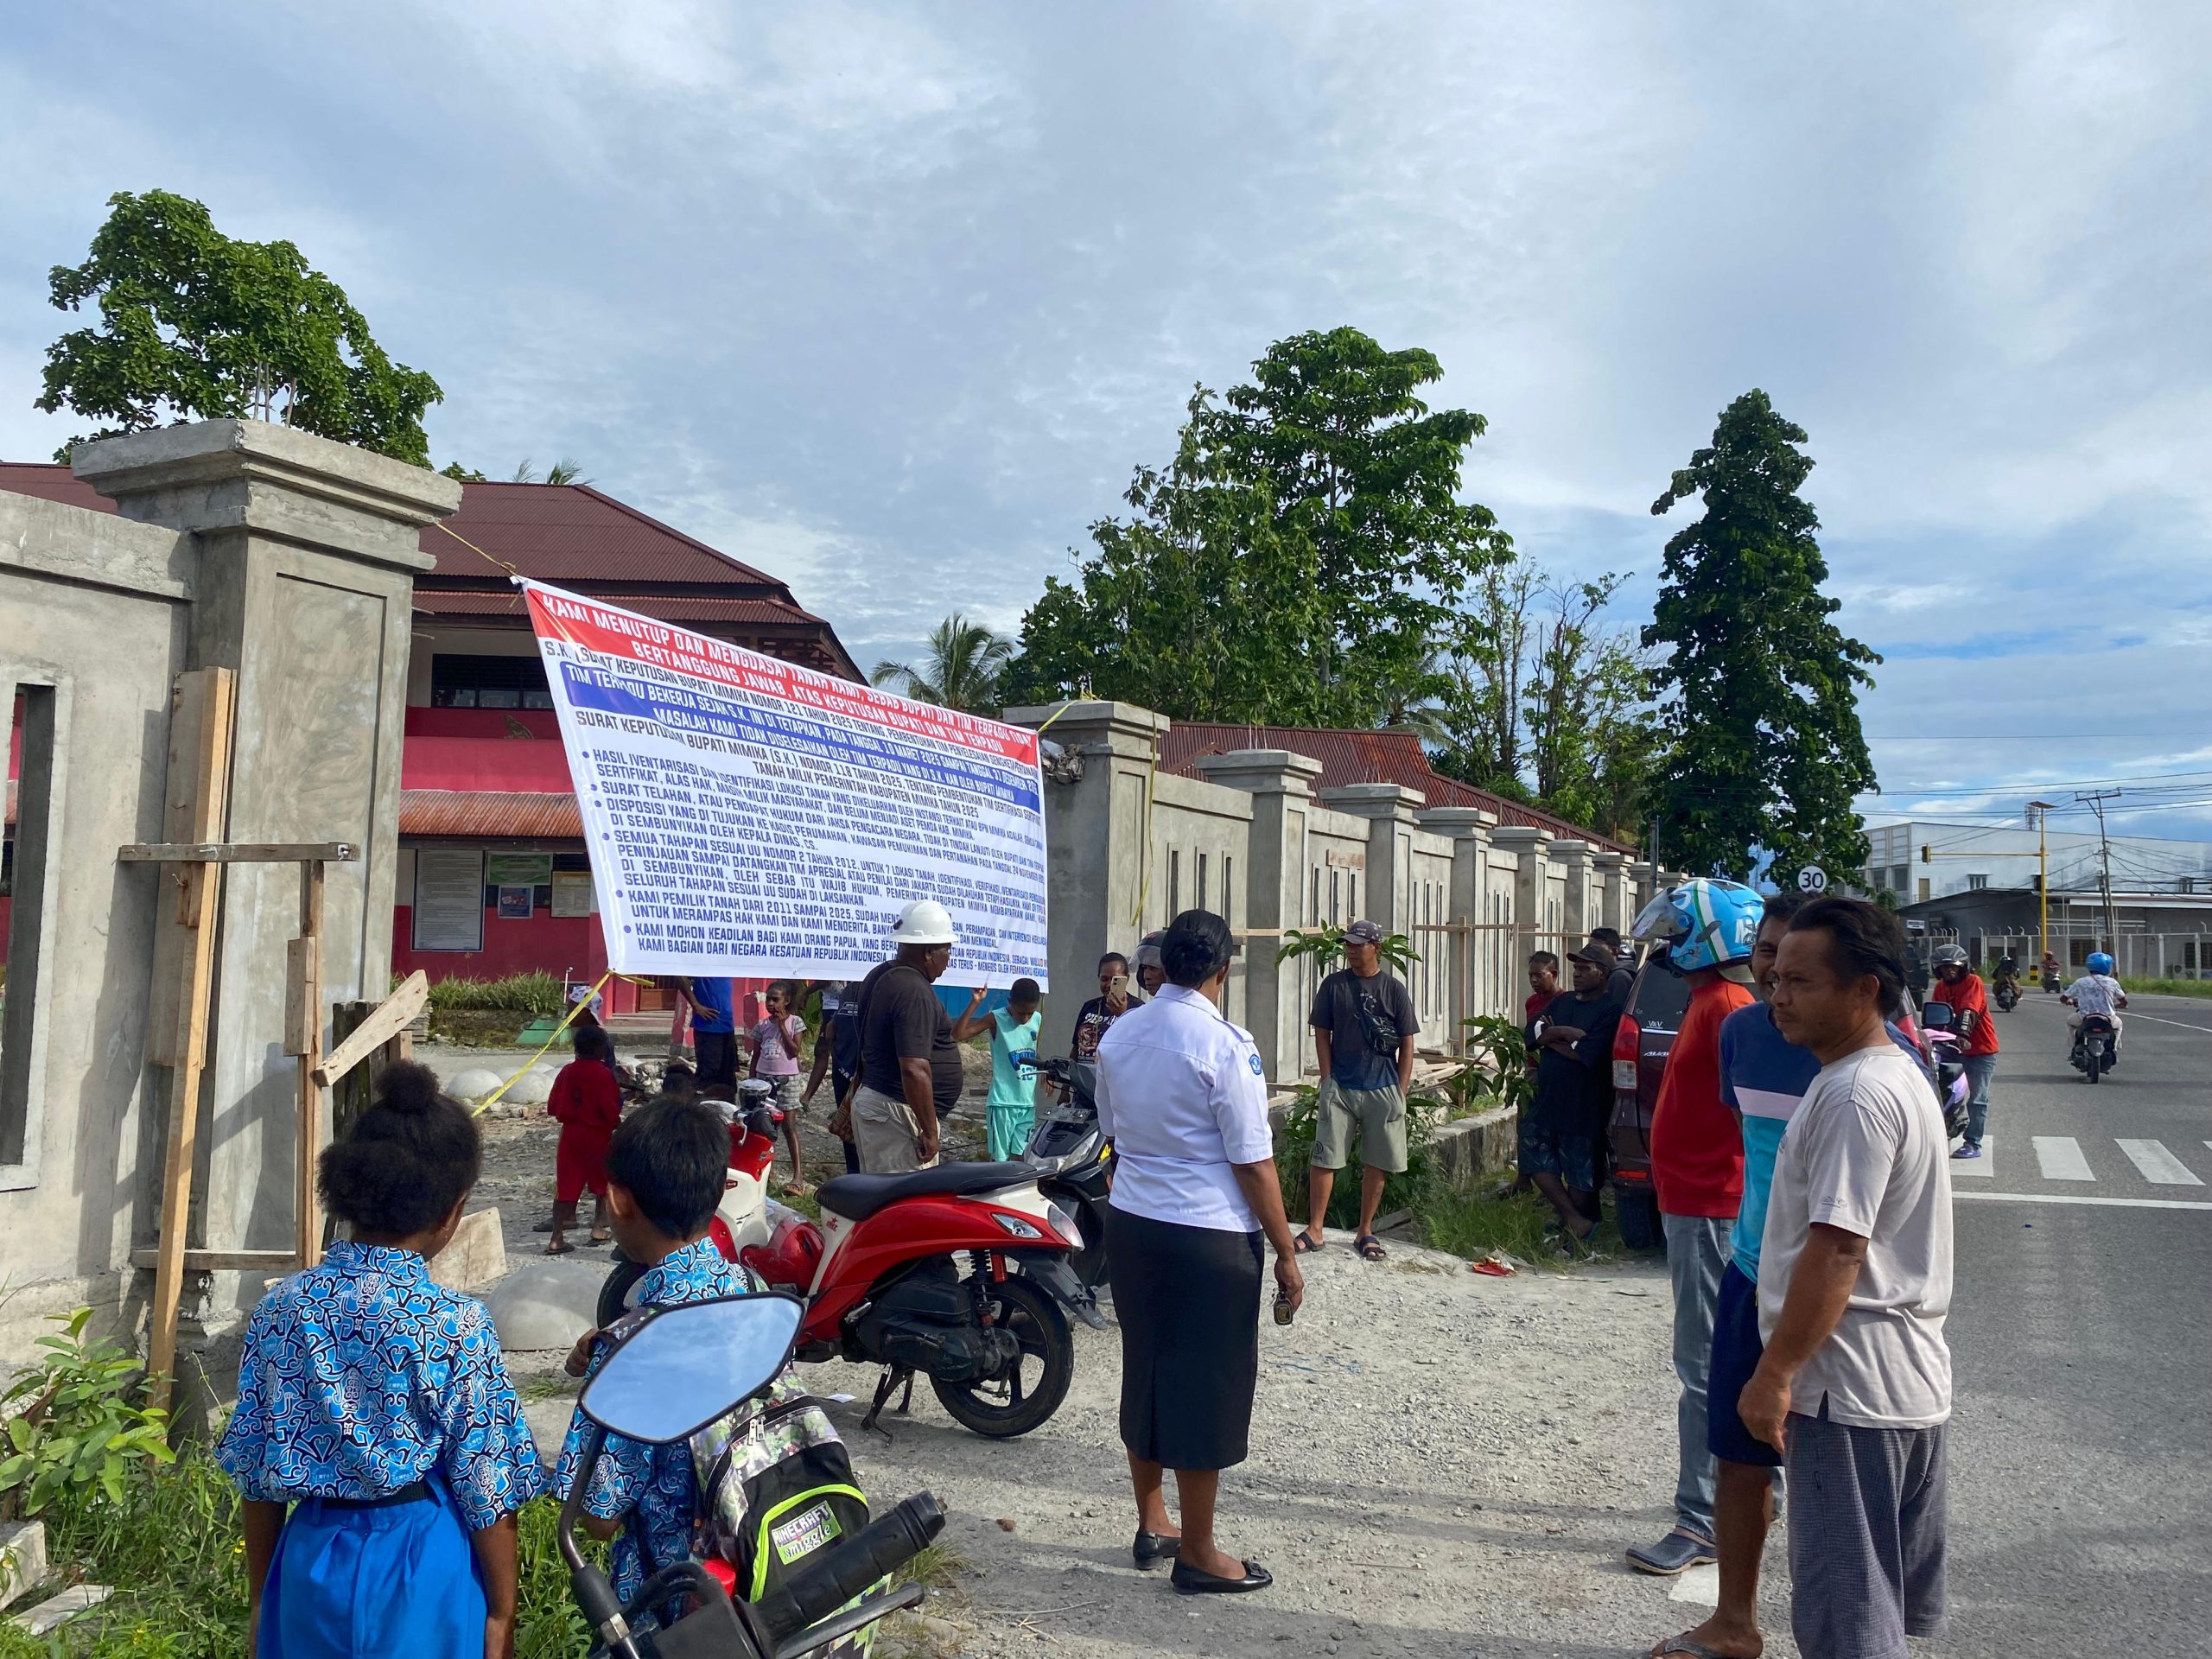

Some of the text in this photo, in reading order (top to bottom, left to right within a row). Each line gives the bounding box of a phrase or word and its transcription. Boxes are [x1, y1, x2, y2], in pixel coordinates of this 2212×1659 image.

[542, 594, 1009, 741] KAMI MENUTUP DAN MENGUASAI TANAH SEBAB BUPATI DAN TIM TERPADU
[543, 641, 852, 729] S.K. KEPUTUSAN BUPATI MIMIKA NOMOR 121 TAHUN 2025
[565, 663, 941, 766] TIM BEKERJA SEJAK S.K. INI DI PADA TANGGAL 10 MARET 2025
[630, 640, 1004, 753] BERTANGGUNG ATAS KEPUTUSAN BUPATI DAN TIM TERPADU
[575, 708, 936, 795] SURAT BUPATI MIMIKA NOMOR 118 TAHUN TENTANG
[652, 705, 921, 778] MASALAH KAMI TIDAK DISELESAIKAN OLEH TIM TERPADU YANG
[592, 747, 913, 817] HASIL IVENTARISASI DAN LOKASI TANAH YANG DIKELUARKAN OLEH
[600, 778, 893, 837] SURAT ATAU PENDAPAT HUKUM DARI JAKSA PENGACARA
[664, 772, 868, 820] ALAS MILIK DAN BELUM
[752, 760, 978, 818] TANAH MILIK PEMERINTAH KABUPATEN MIMIKA TAHUN 2025
[605, 794, 978, 867] DISPOSISI YANG DI TUJUKAN KE KAWASAN PEMUKIMAN DAN PERTANAHAN
[610, 811, 771, 843] DI SEMBUNYIKAN OLEH KEPALA
[613, 827, 914, 878] SEMUA TAHAPAN SESUAI UU NOMOR 2 TAHUN UNTUK LOKASI
[616, 841, 936, 893] PENINJAUAN SAMPAI DATANGKAN TIM APRESIAL ATAU PENILAI DARI JAKARTA
[620, 858, 847, 893] DI OLEH SEBAB ITU WAJIB
[622, 870, 817, 901] SELURUH TAHAPAN SESUAI UU SUDAH DI
[1801, 872, 1824, 889] 30
[626, 888, 661, 905] KAMI
[662, 891, 706, 908] PEMILIK
[708, 895, 741, 910] TANAH
[742, 898, 764, 912] DARI
[766, 900, 791, 914] 2011
[793, 903, 827, 918] SAMPAI
[855, 909, 879, 922] SUDAH
[630, 902, 823, 930] UNTUK MERAMPAS HAK KAMI DAN KAMI
[634, 921, 664, 938] KAMI
[665, 924, 705, 939] MOHON
[707, 926, 754, 943] KEADILAN
[755, 930, 778, 943] BAGI
[779, 931, 802, 944] KAMI
[804, 933, 830, 946] ORANG
[861, 938, 879, 950] YANG
[637, 937, 849, 960] KAMI BAGIAN DARI NEGARA KESATUAN REPUBLIK
[773, 1504, 830, 1547] MINECRAFT
[784, 1524, 831, 1559] smiggle
